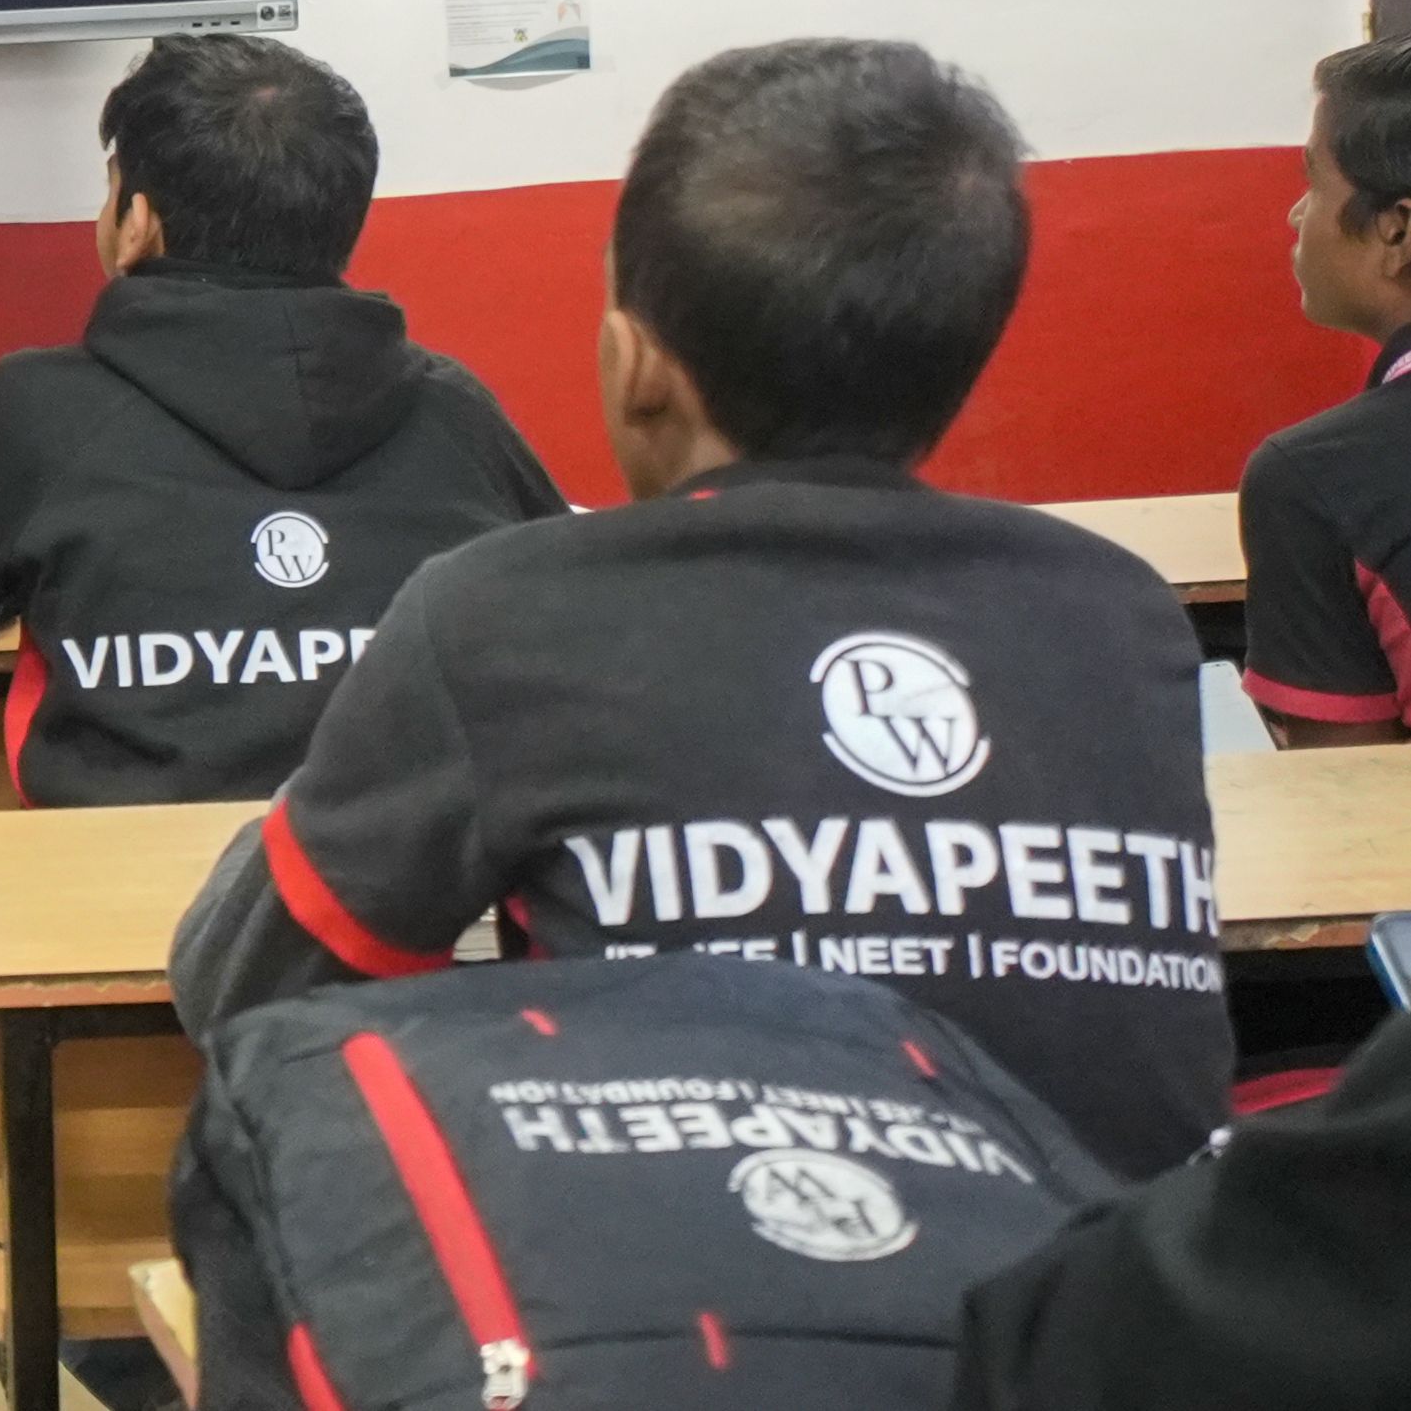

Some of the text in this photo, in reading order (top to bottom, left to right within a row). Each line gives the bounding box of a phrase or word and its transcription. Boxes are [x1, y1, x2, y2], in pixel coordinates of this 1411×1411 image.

[564, 816, 1219, 937] VIDYAPEETH
[822, 935, 952, 975] NEET
[991, 939, 1221, 993] FOUNDATION
[503, 1101, 1035, 1185] VIDYAPEETH
